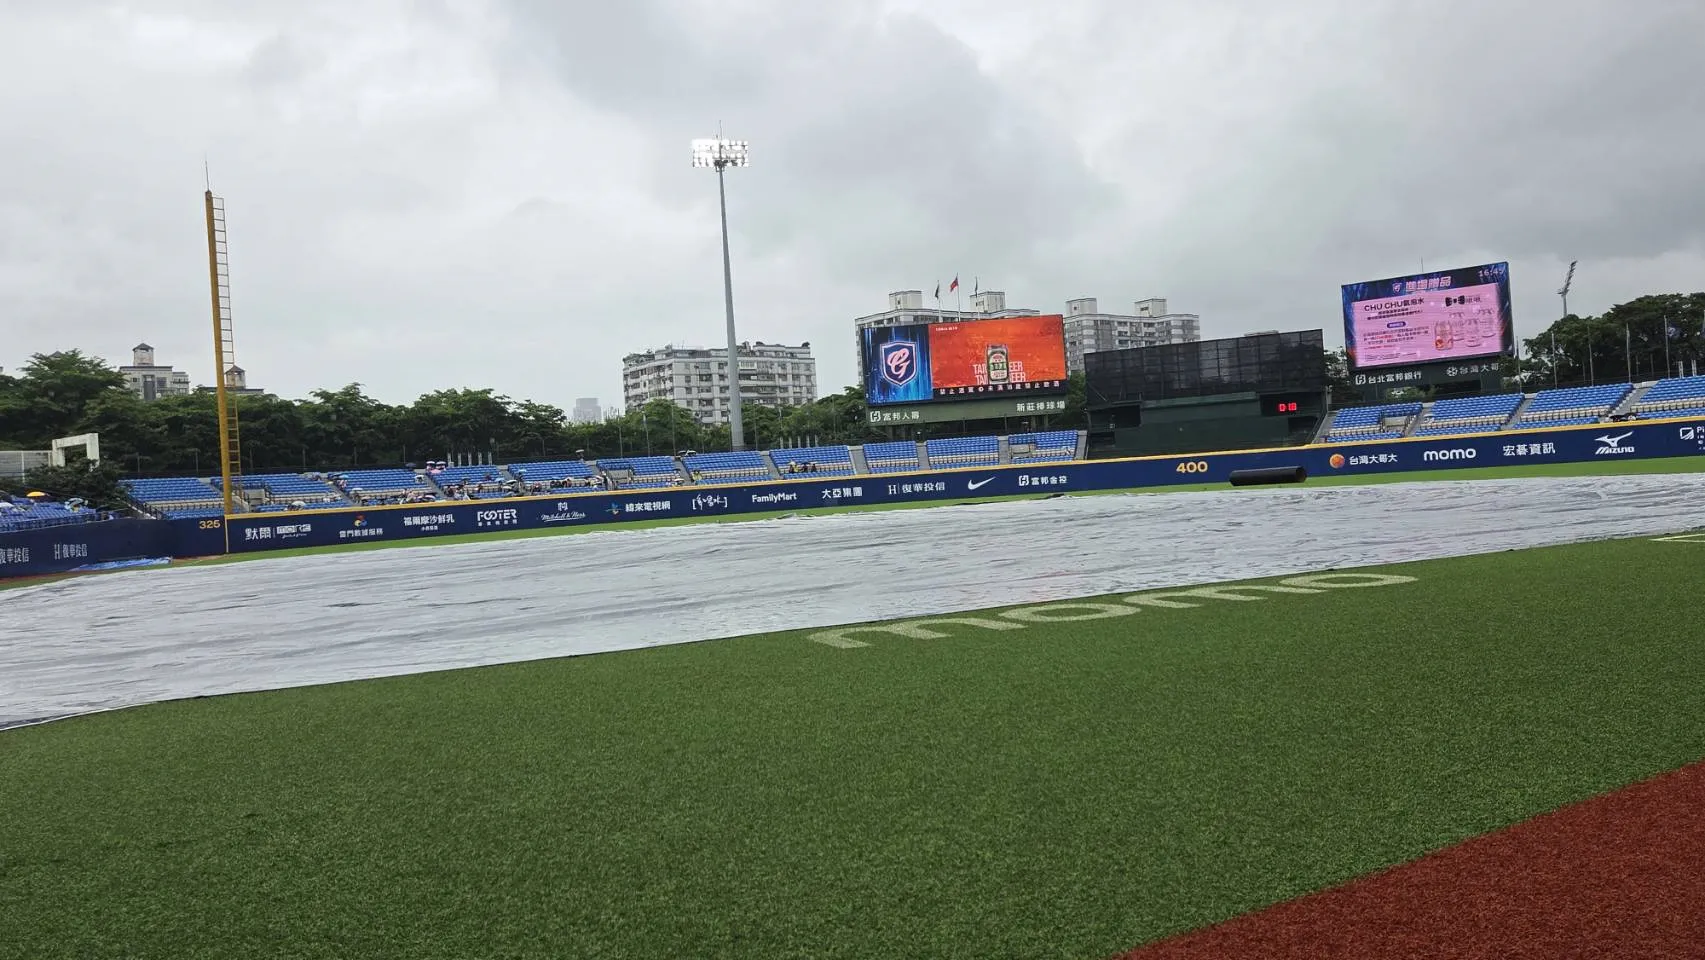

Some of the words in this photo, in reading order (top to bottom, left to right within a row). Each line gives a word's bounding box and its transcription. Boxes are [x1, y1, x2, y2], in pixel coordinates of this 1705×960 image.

[1364, 303, 1383, 312] CHU
[1368, 371, 1422, 384] 台北富邦銀行
[1016, 400, 1066, 412] 新莊棒球場
[883, 411, 920, 421] 富邦人壽
[1423, 447, 1477, 461] momo
[1503, 442, 1556, 457] 宏碁資訊
[1349, 453, 1398, 465] 台灣大哥大
[1176, 461, 1208, 474] 400
[1031, 475, 1067, 486] 富邦金控
[821, 486, 863, 499] 大亞集團
[902, 482, 945, 494] 復華投信
[752, 492, 797, 504] FamilyMart
[403, 513, 455, 526] 福爾摩沙鮮乳
[477, 508, 517, 522] FOOTER
[199, 520, 221, 529] 325
[245, 526, 272, 540] 默爾
[806, 572, 1419, 650] momo
